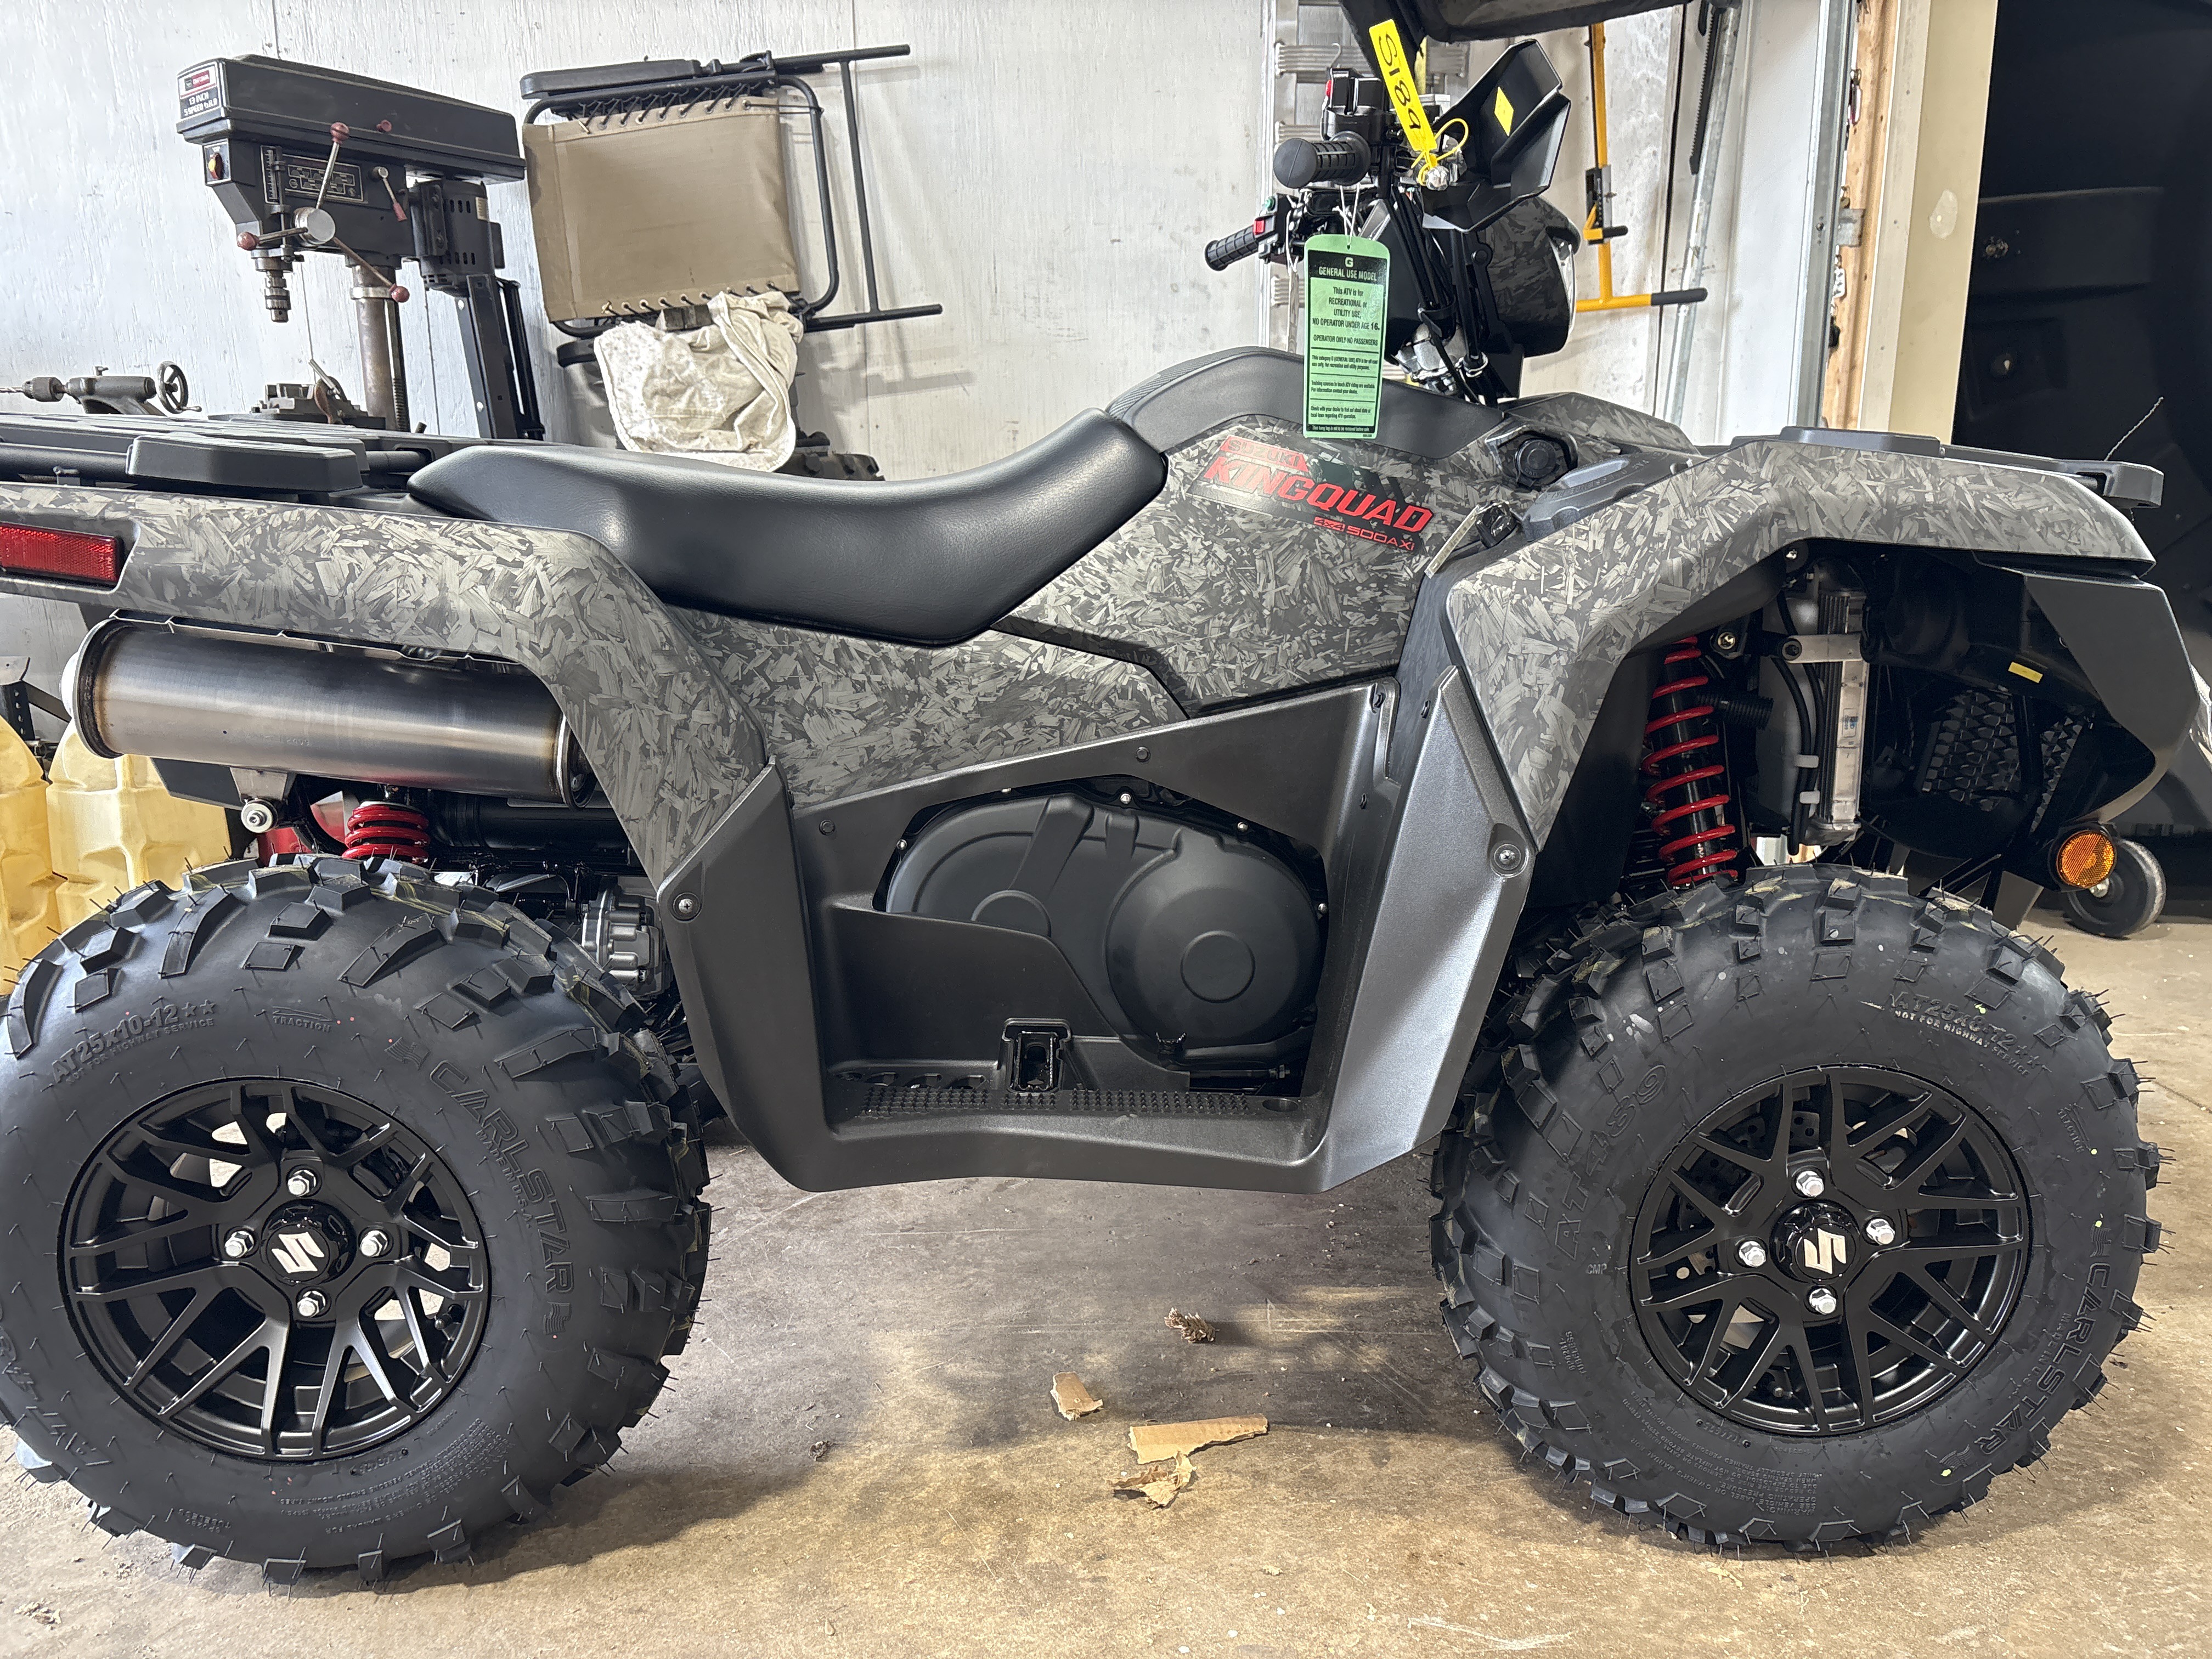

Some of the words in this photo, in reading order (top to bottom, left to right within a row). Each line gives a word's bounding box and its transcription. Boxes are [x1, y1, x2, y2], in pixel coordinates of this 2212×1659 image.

[1378, 33, 1420, 129] S189
[1319, 267, 1345, 277] GENERAL
[1347, 269, 1357, 279] USE
[1358, 271, 1377, 281] MODEL
[1345, 257, 1353, 267] G
[1321, 319, 1344, 327] OPERATOR
[1329, 297, 1361, 307] RECREATIONAL
[1228, 437, 1300, 467] SUZUKI
[1204, 456, 1434, 532] KINGQUAD
[273, 1015, 331, 1032] TRACTION
[1895, 1011, 1916, 1020] NOT
[1919, 1015, 1940, 1028] FOR
[1944, 1023, 1990, 1048] HIGHWAY
[1992, 1046, 2030, 1077] SERVICE
[66, 1068, 84, 1085] NOT
[87, 1053, 108, 1070] FOR
[110, 1029, 159, 1056] HIGHWAY
[165, 1018, 215, 1034] SERVICE
[429, 1060, 574, 1294] CARLSTAR
[476, 1130, 506, 1166] MADE
[502, 1167, 516, 1183] IN
[1564, 1330, 1587, 1375] TUBELESS
[1974, 1262, 2111, 1455] CARLSTAR
